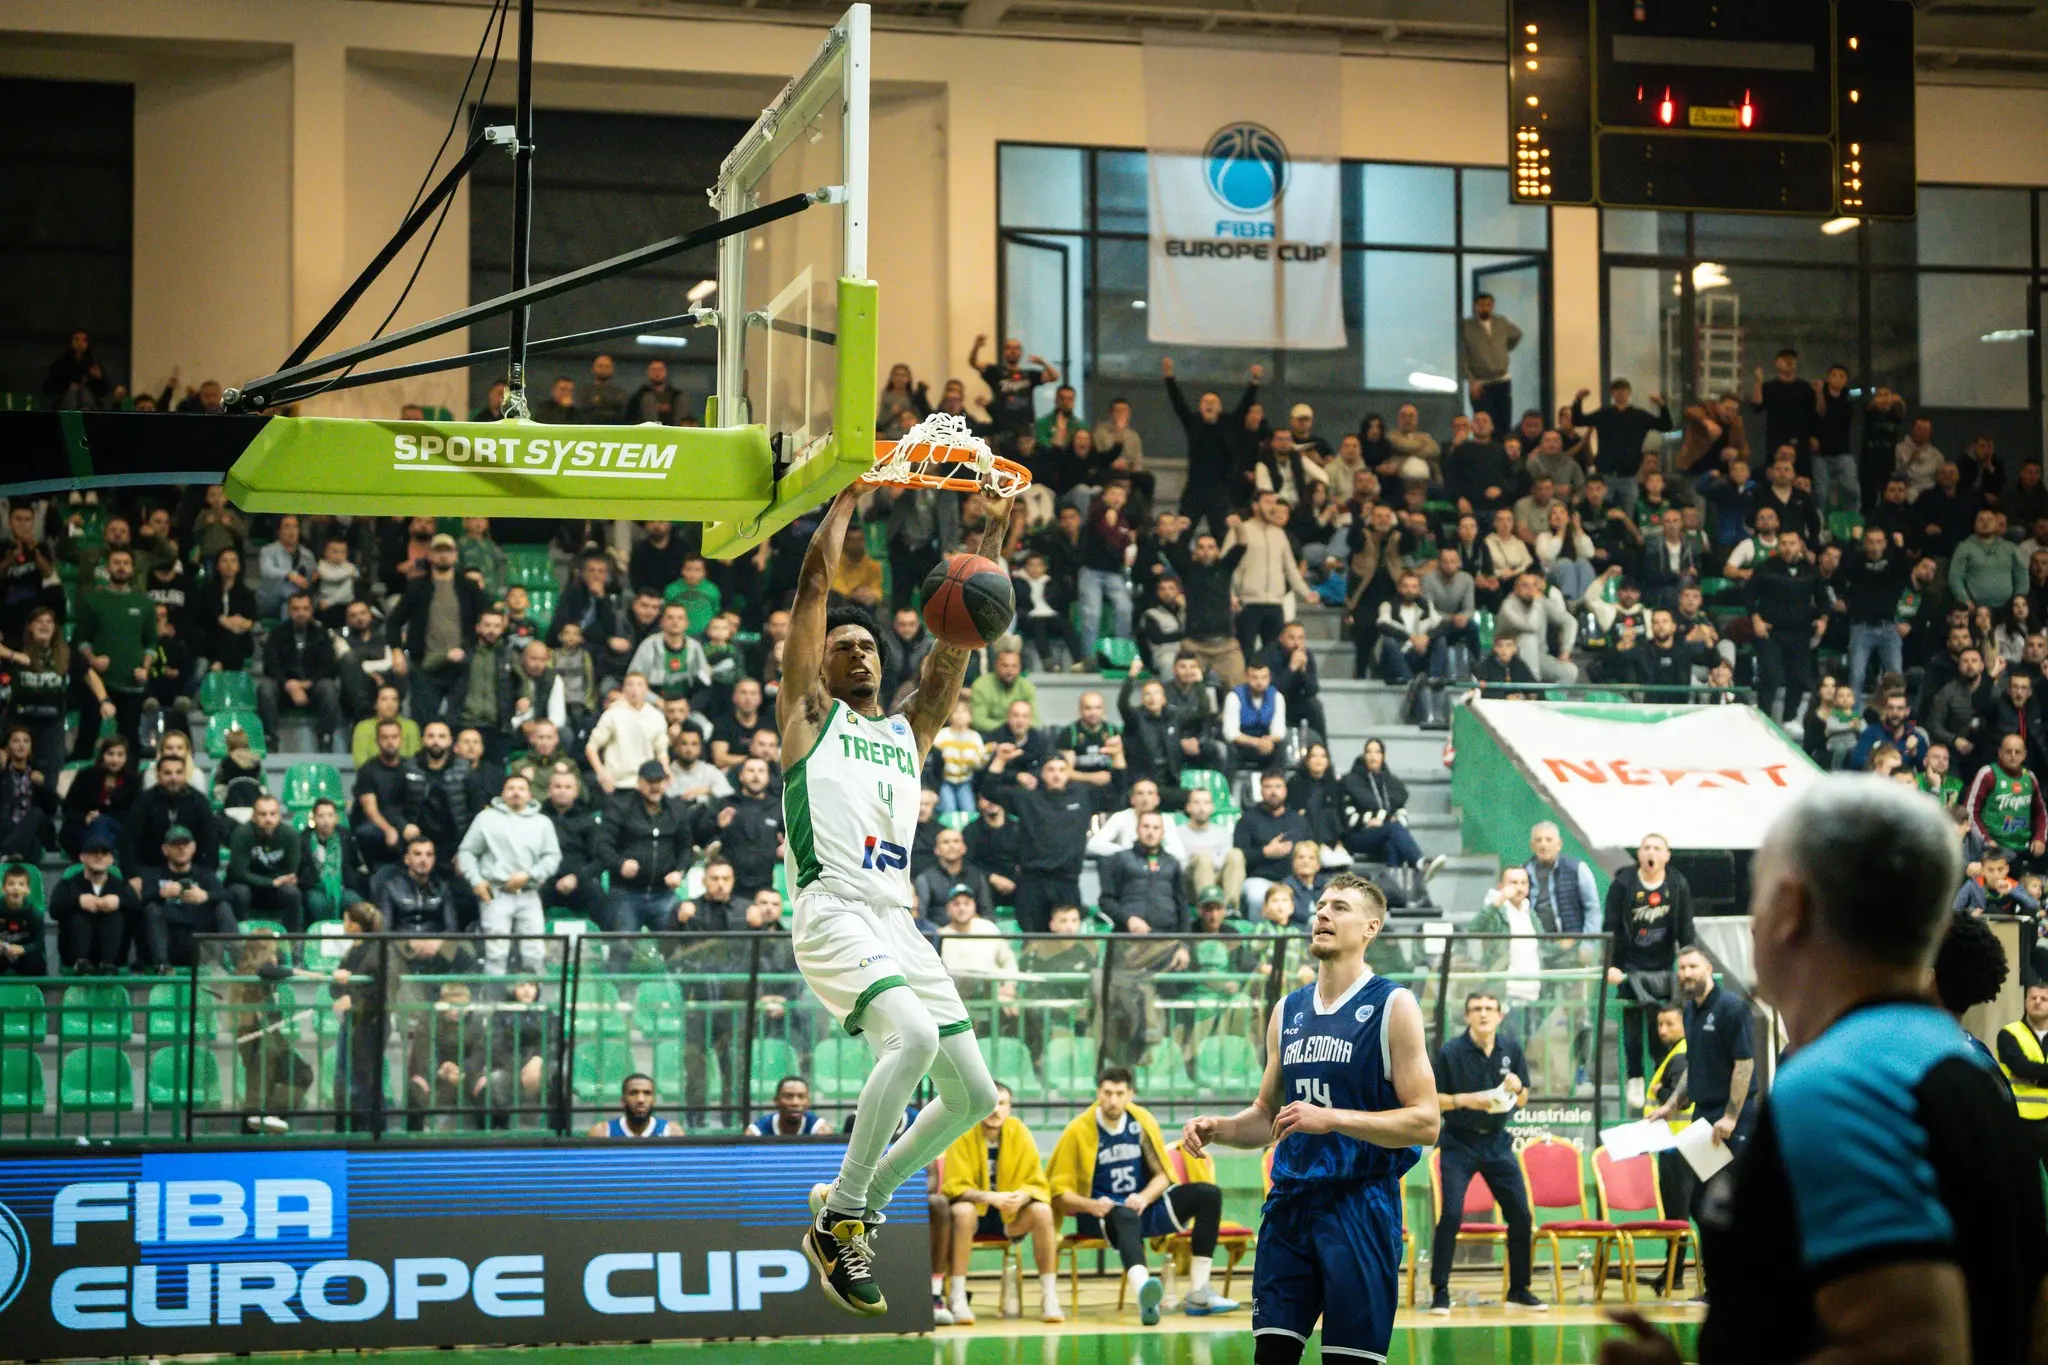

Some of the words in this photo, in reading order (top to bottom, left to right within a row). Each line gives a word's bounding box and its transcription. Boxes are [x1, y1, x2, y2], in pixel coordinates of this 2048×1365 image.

[1215, 219, 1276, 238] FIBA
[1165, 240, 1270, 260] EUROPE
[1276, 245, 1327, 262] CUP
[394, 434, 521, 464] SPORT
[523, 439, 678, 475] SYSTEM
[878, 781, 894, 818] 4
[1283, 1035, 1353, 1066] CALEDONIA
[1110, 1166, 1137, 1193] 25
[52, 1179, 333, 1246] FIBA
[50, 1255, 545, 1330] EUROPE
[583, 1250, 810, 1314] CUP
